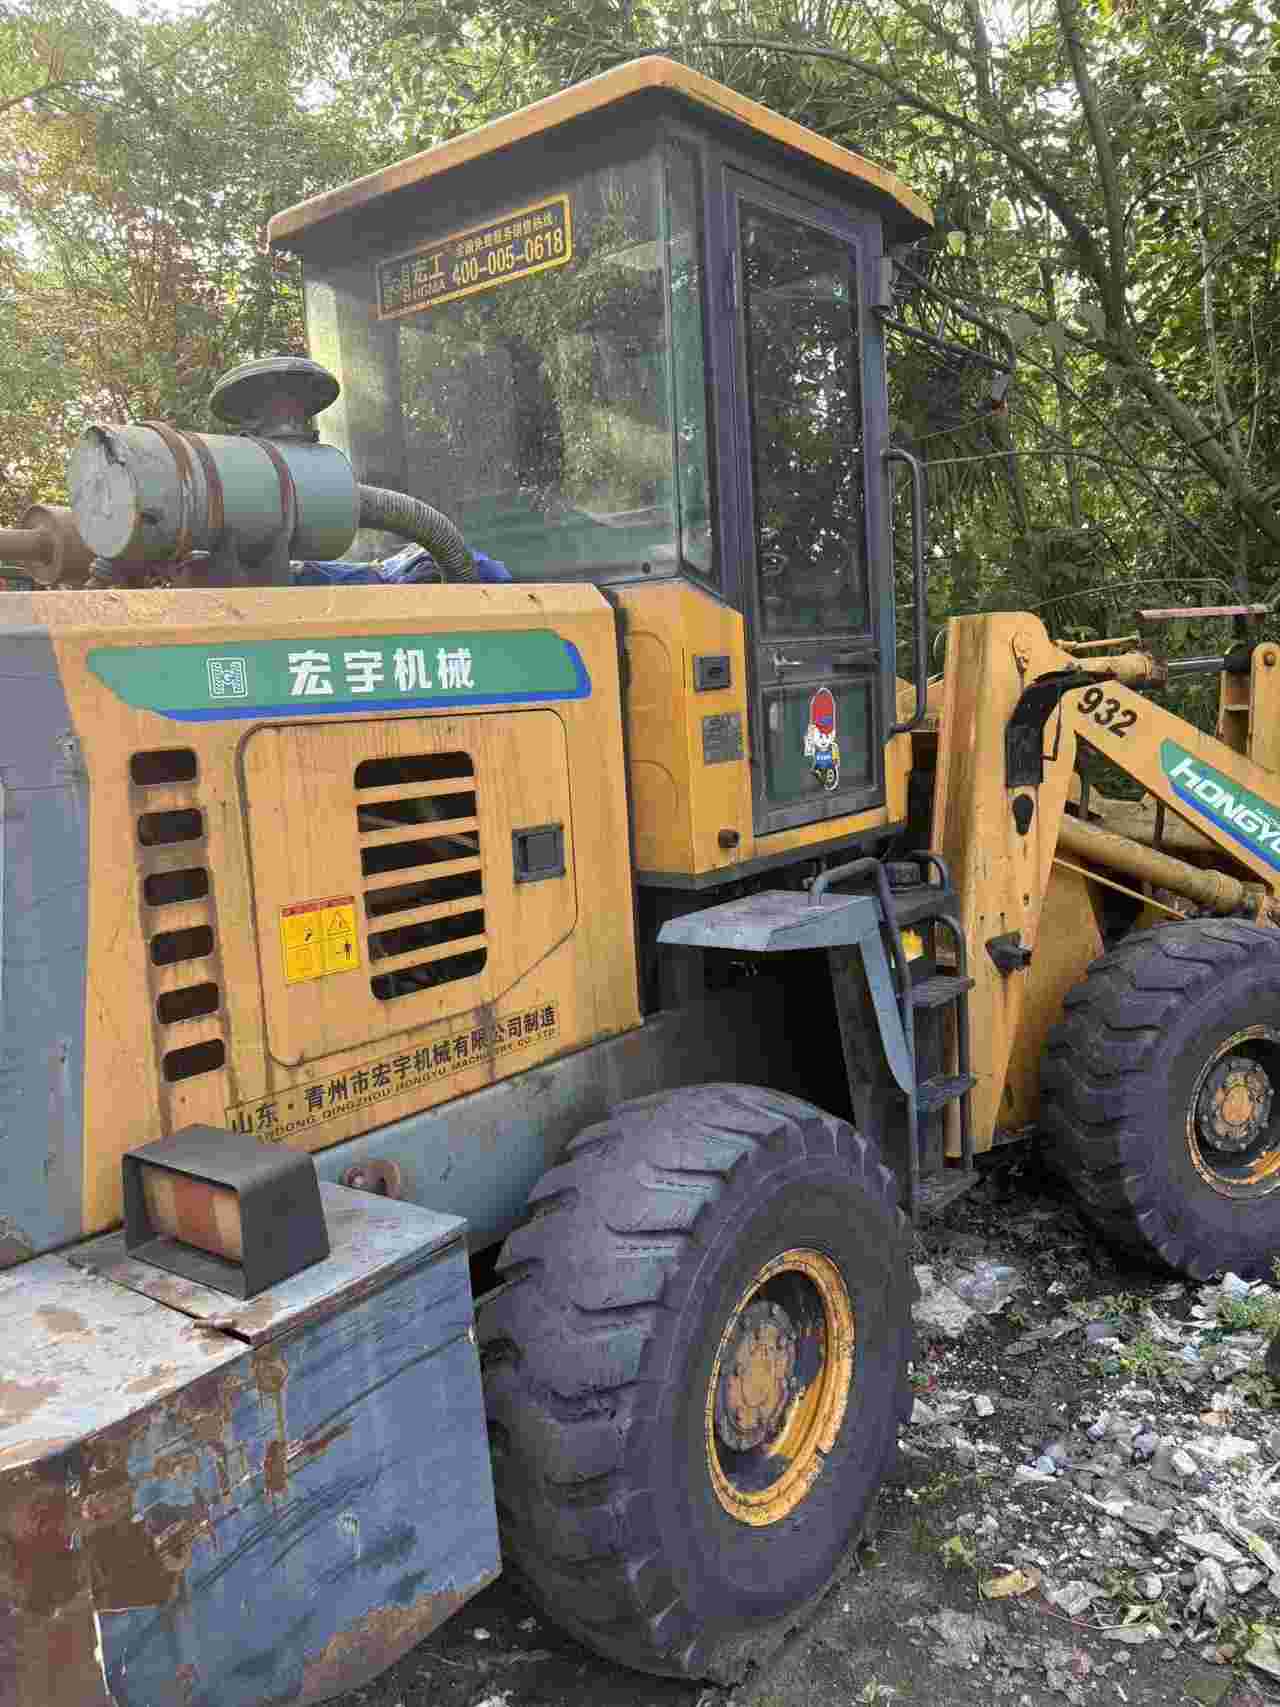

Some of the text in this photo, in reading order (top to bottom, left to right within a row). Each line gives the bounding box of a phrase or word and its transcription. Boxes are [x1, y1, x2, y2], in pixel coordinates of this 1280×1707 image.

[451, 228, 564, 286] 400-005-0618
[287, 647, 475, 697] 宏宇机械
[1078, 687, 1138, 738] 932
